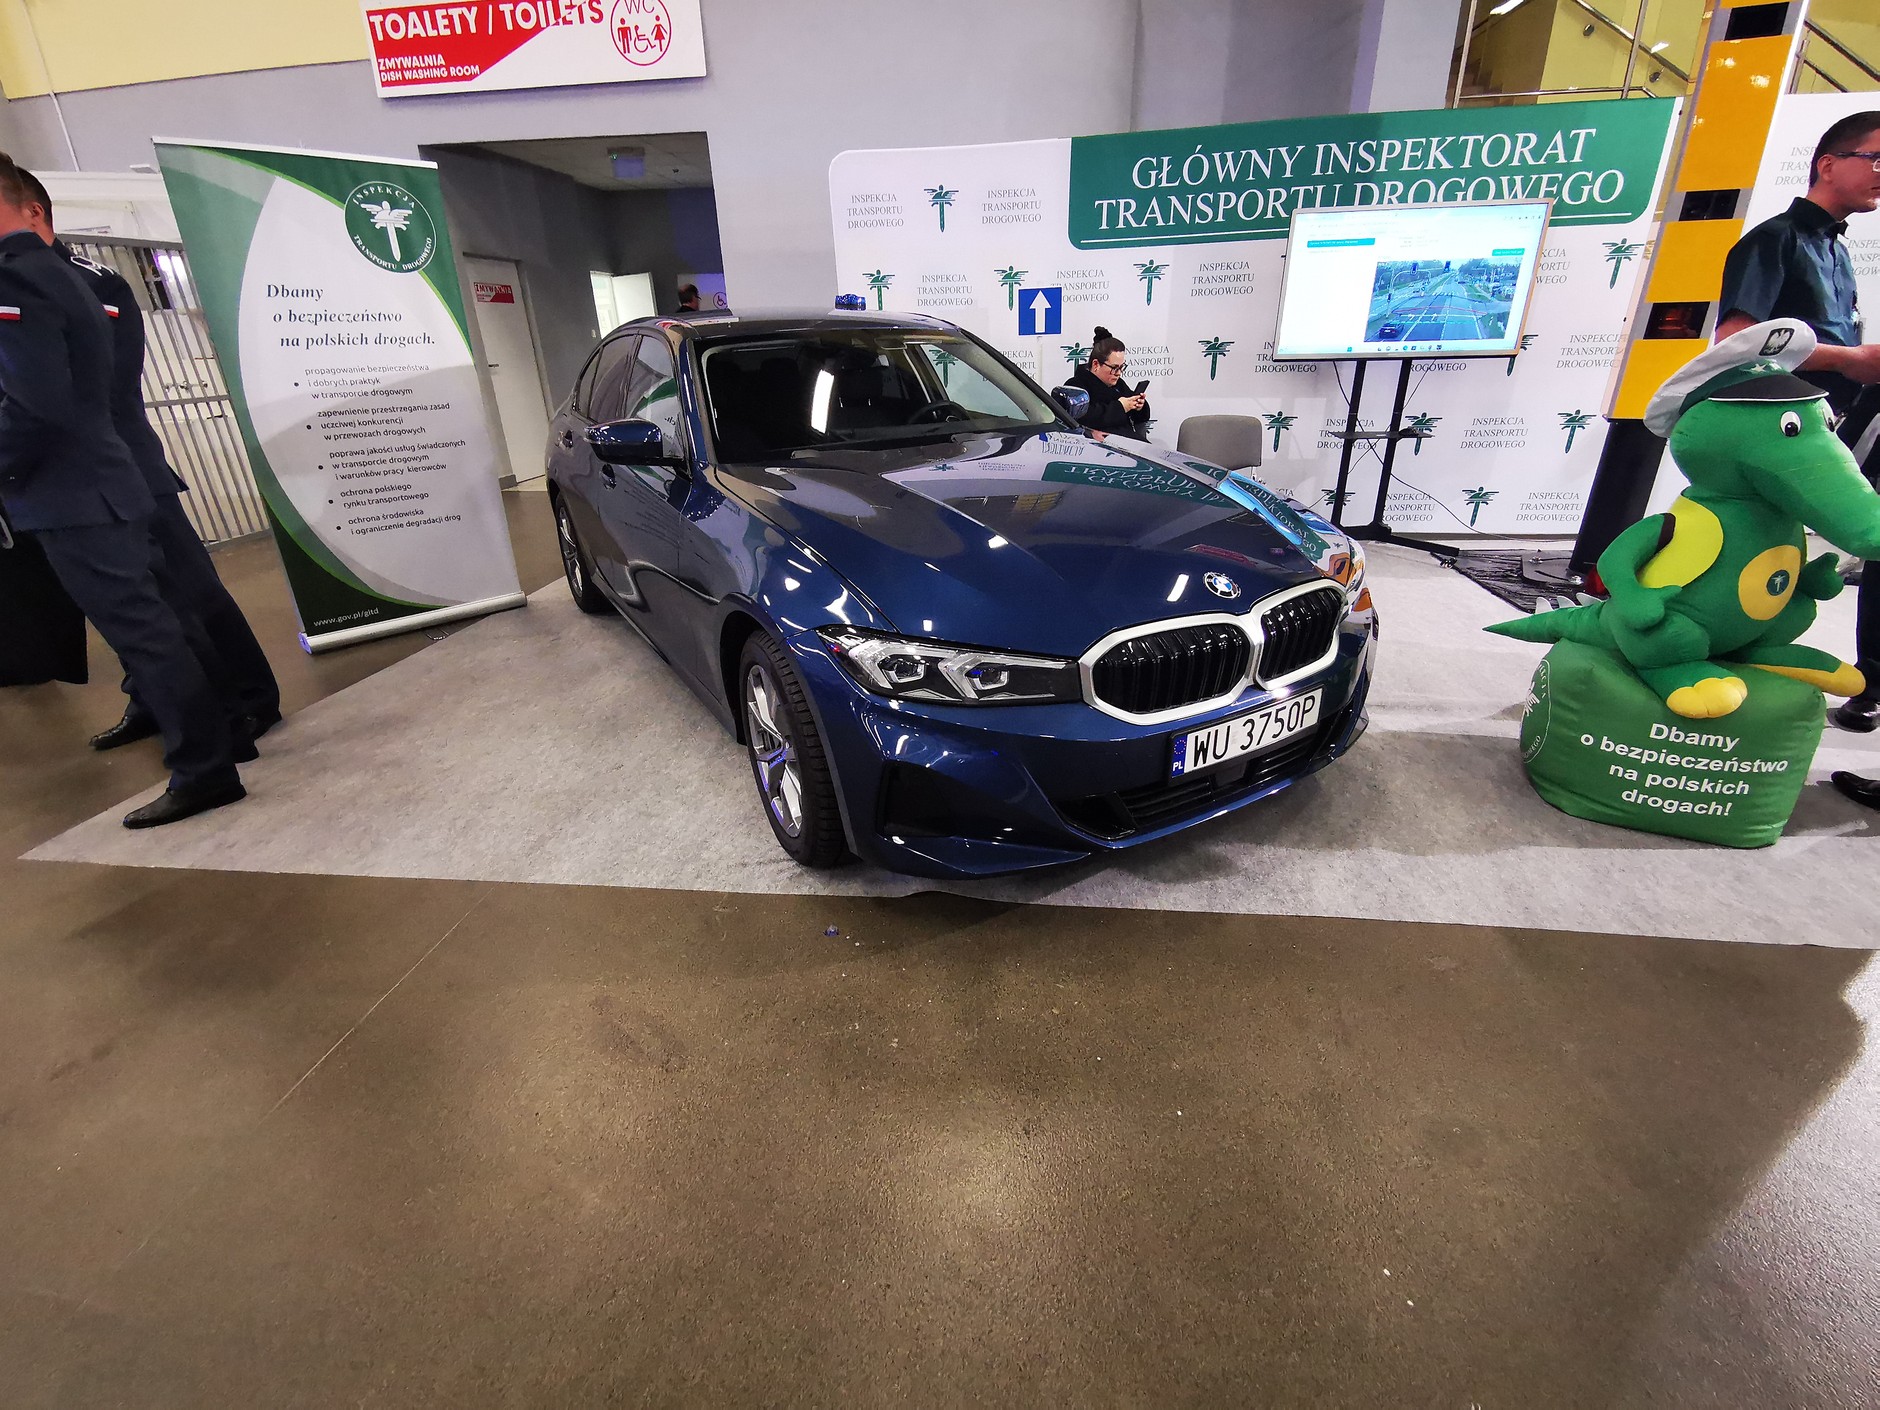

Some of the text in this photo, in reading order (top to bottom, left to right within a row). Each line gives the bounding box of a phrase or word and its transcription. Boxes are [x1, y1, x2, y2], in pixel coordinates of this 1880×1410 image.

[624, 0, 655, 14] WC
[369, 0, 603, 41] TOALETY / TOILETS
[378, 54, 446, 70] ZMYWALNIA
[381, 64, 480, 82] DISH WASHING ROOM
[1314, 127, 1596, 178] INSPEKTORAT
[1132, 143, 1304, 191] GŁÓWNY
[851, 193, 897, 204] INSPEKCJA
[987, 188, 1036, 198] INSPEKCJA
[1095, 168, 1624, 231] TRANSPORTU DROGOWEGO
[847, 205, 903, 217] TRANSPORTU
[982, 200, 1041, 212] TRANSPORTU
[847, 218, 904, 229] DROGOWEGO
[982, 213, 1042, 225] DROGOWEGO
[354, 234, 397, 270] TRANSPORTU
[402, 237, 432, 271] DROGOWEGO
[1200, 261, 1250, 272] INSPEKCJA
[921, 273, 967, 284] INSPEKCJA
[1056, 269, 1105, 279] INSPEKCJA
[1192, 273, 1255, 285] TRANSPORTU
[267, 284, 324, 301] Dbamy
[917, 285, 973, 295] TRANSPORTU
[1190, 286, 1254, 297] DROGOWEGO
[917, 297, 973, 307] DROGOWEGO
[1062, 293, 1110, 303] OGOWEGO
[273, 309, 402, 326] o bezpieczeństwo
[280, 332, 435, 349] na polskich drogach.
[1125, 346, 1170, 355] NSPEKCJA
[1127, 357, 1175, 366] ANSPORTU
[1410, 362, 1467, 372] ROGOWEGO
[305, 364, 429, 376] propagowanie bezpieczeństwa
[1122, 368, 1174, 378] ROGOWEGO
[1254, 364, 1317, 373] DROGOWEGO
[313, 378, 348, 387] dobrych
[350, 377, 381, 387] praktyk
[321, 389, 369, 400] transporcie
[370, 388, 413, 399] drogowym
[317, 403, 450, 419] zapewnienie przestrzegania zasad
[320, 417, 404, 430] uczciwej konkurencji
[1326, 418, 1375, 427] INSPCJA
[1472, 417, 1525, 426] INSPEKCJA
[333, 429, 382, 441] przewozach
[382, 426, 426, 438] drogowych
[1463, 428, 1529, 438] TRANSPORTU
[329, 439, 466, 459] poprawa jakości usług świadczonych
[1460, 440, 1525, 449] DROGOWEGO
[341, 458, 387, 470] transporcie
[388, 454, 429, 465] drogowym
[339, 469, 382, 480] warunków
[383, 468, 404, 477] pracy
[407, 463, 447, 473] kierowców
[340, 483, 412, 498] ochrona polskiego
[1528, 491, 1580, 500] INSPEKCJA
[343, 492, 429, 509] rynku transportowego
[1387, 493, 1432, 501] NSPEKCJA
[1386, 503, 1436, 511] ANSPORTU
[1519, 502, 1583, 512] TRANSPORTU
[348, 508, 424, 525] ochrona środowiska
[1384, 514, 1433, 522] OGOWEGO
[1516, 513, 1580, 522] DROGOWEGO
[355, 522, 405, 535] ograniczenie
[405, 518, 443, 528] degradacji
[314, 608, 379, 627] www.gov.pl/gitd
[1193, 694, 1316, 767] WU 3750P
[1649, 723, 1740, 752] Dbamy
[1580, 733, 1788, 773] o bezpieczeństwo
[1172, 760, 1183, 771] PL
[1609, 763, 1750, 796] na polskich
[1621, 789, 1733, 817] drogach!
